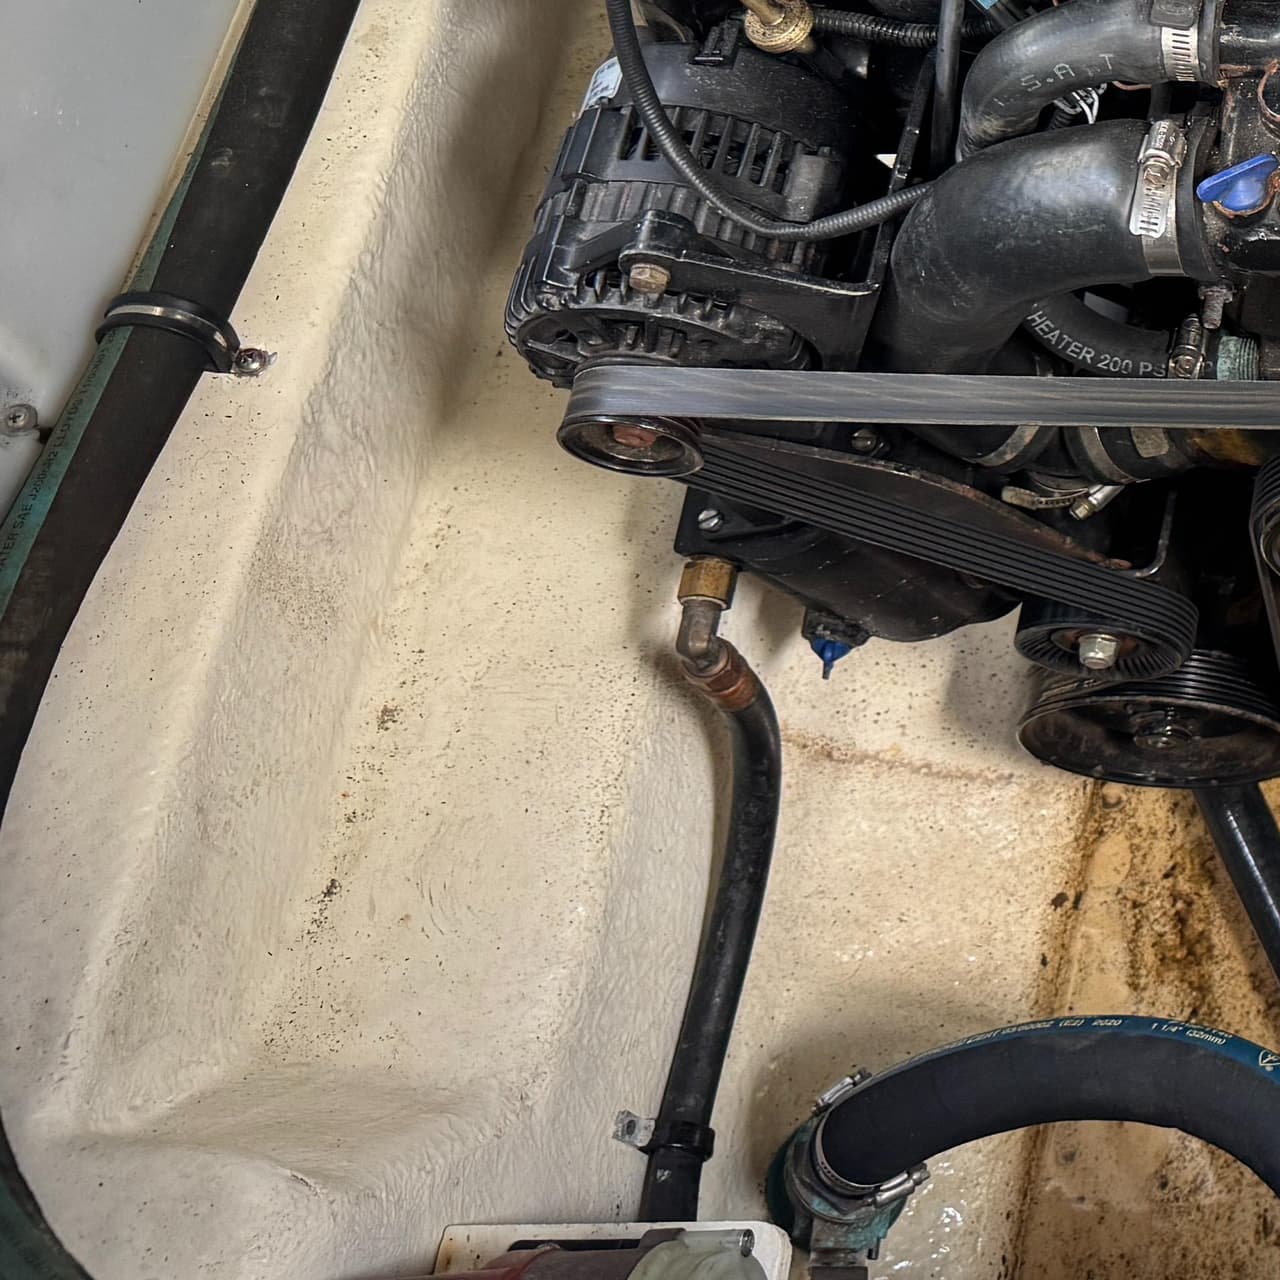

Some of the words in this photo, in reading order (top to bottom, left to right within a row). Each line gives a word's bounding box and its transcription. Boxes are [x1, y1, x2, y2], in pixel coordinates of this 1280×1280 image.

[1026, 307, 1095, 364] HEATER
[1096, 353, 1133, 375] 200
[1186, 1028, 1226, 1045] (32mm)
